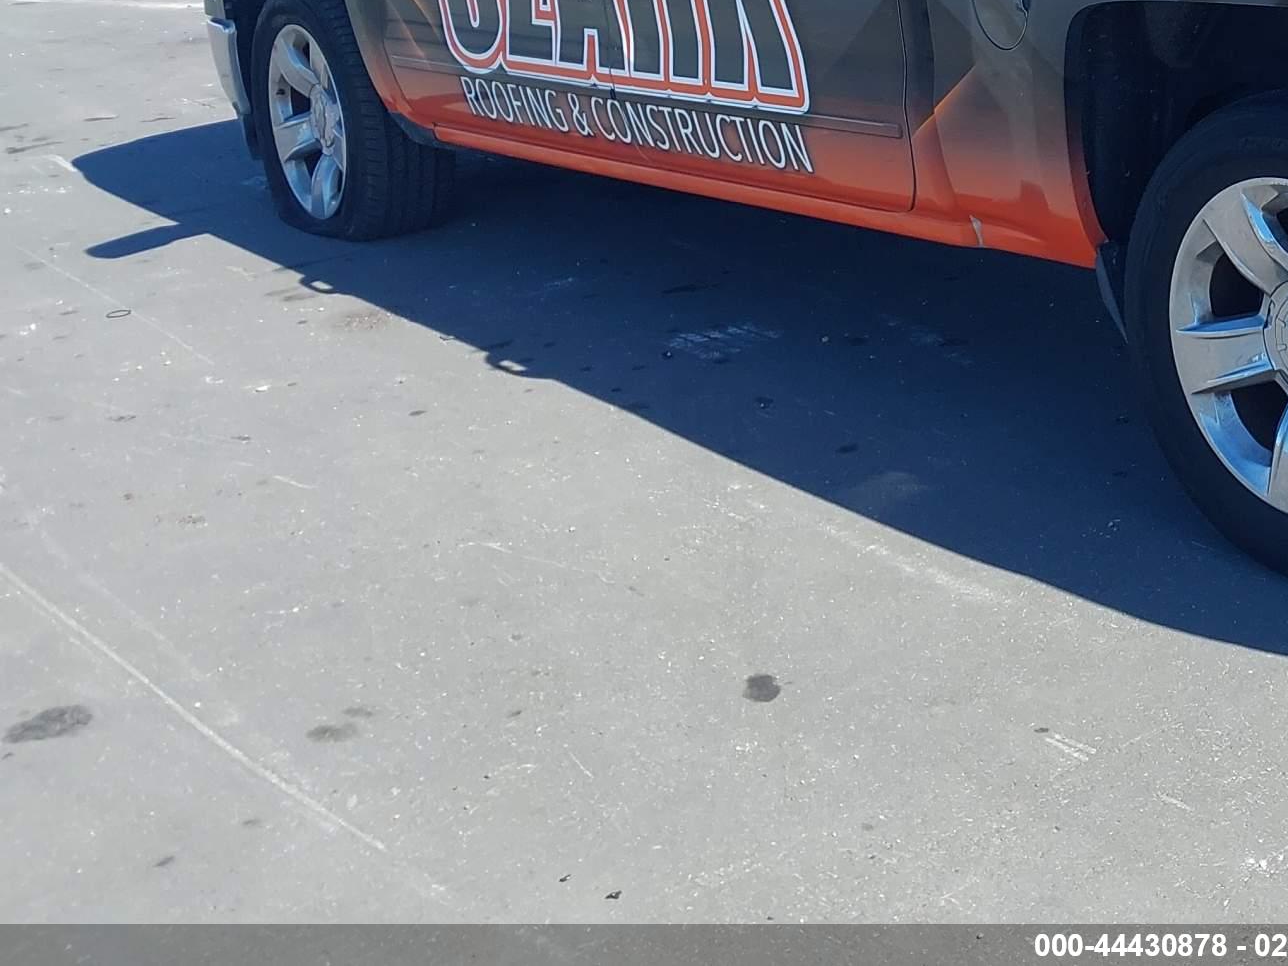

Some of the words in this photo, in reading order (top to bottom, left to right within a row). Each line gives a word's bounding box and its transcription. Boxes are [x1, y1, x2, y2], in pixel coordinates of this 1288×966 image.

[460, 75, 567, 133] ROOFING
[567, 92, 593, 139] &
[590, 96, 814, 174] CONSTRUCTION
